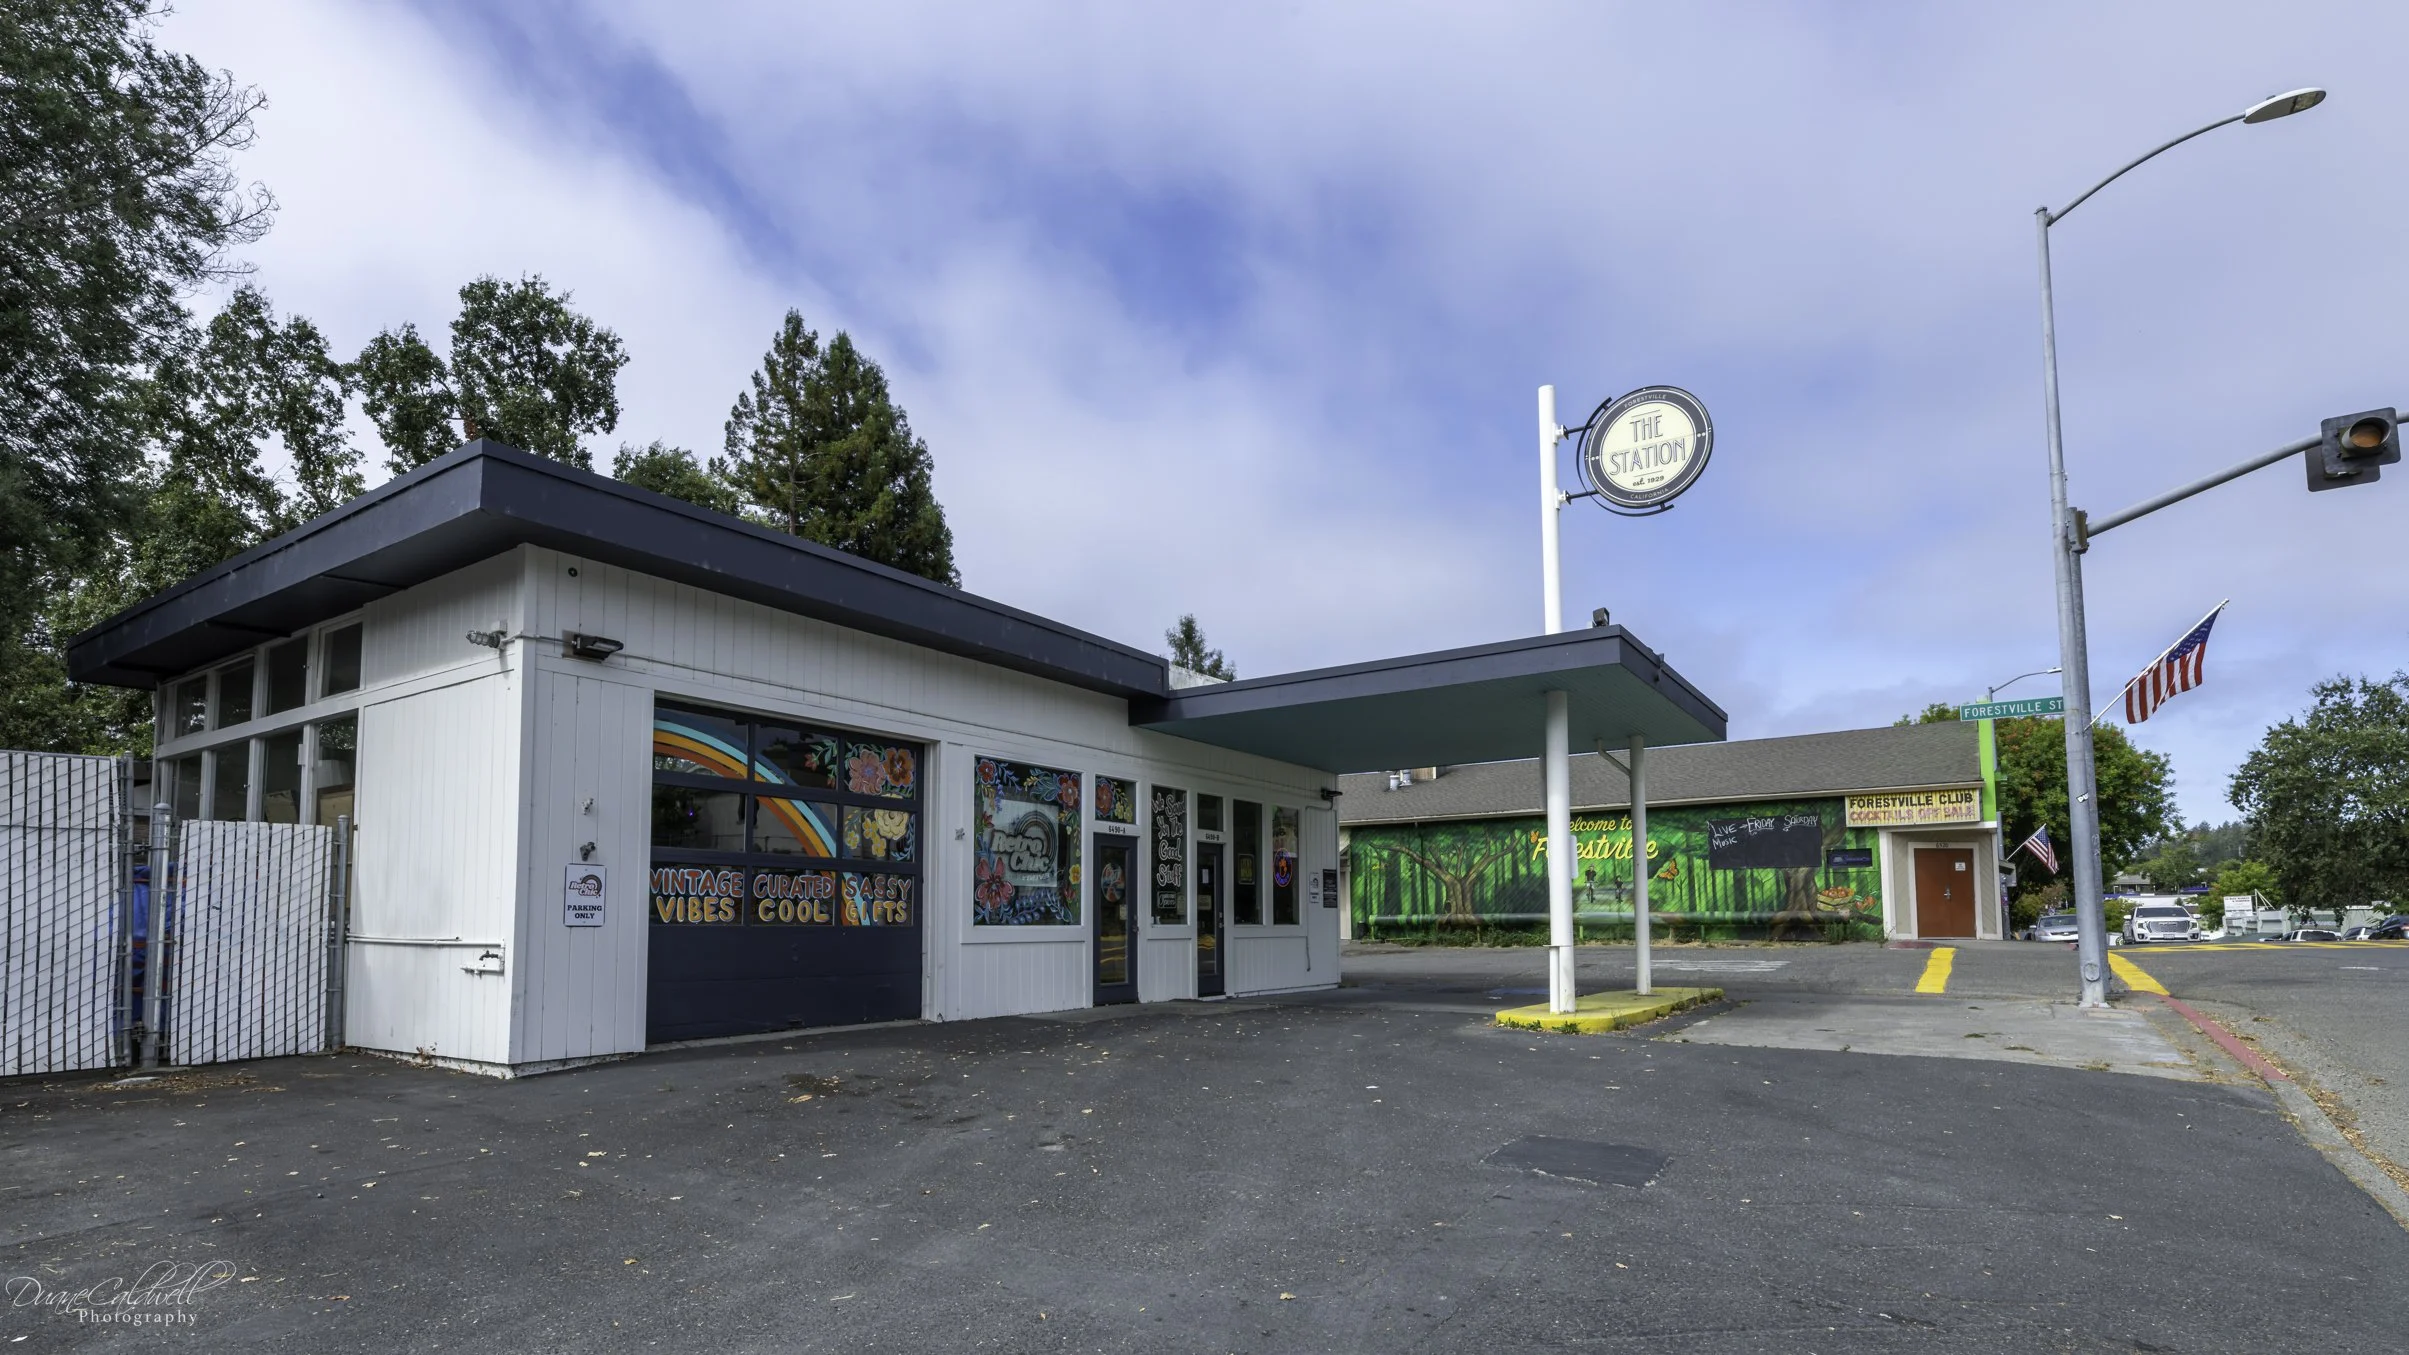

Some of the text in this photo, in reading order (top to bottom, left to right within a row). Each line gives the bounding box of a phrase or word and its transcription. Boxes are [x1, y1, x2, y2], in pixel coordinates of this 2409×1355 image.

[1623, 393, 1667, 408] FORESTVILLE
[1629, 414, 1664, 443] THE
[1609, 437, 1686, 476] STATION
[1630, 487, 1669, 500] CALIFORNIA
[1964, 699, 2064, 718] FORESTVILLE ST
[1849, 792, 1974, 809] FORESTVILLE CLUB
[1569, 814, 1632, 831] elcome to
[1849, 808, 1914, 821] COCKTAILS
[1710, 823, 1737, 837] LIVE
[1747, 817, 1775, 833] FRIDAY
[991, 829, 1045, 855] Retro
[1158, 838, 1182, 861] Good
[1009, 850, 1052, 873] Chic
[569, 881, 597, 891] Retro
[650, 868, 744, 898] VINTAGE
[753, 874, 835, 899] CURATED
[1156, 863, 1182, 887] Stuff
[578, 888, 599, 897] Chic
[844, 876, 912, 900] SASSY
[656, 896, 735, 923] VIBES
[758, 899, 830, 922] COOL
[845, 900, 907, 922] GIFTS
